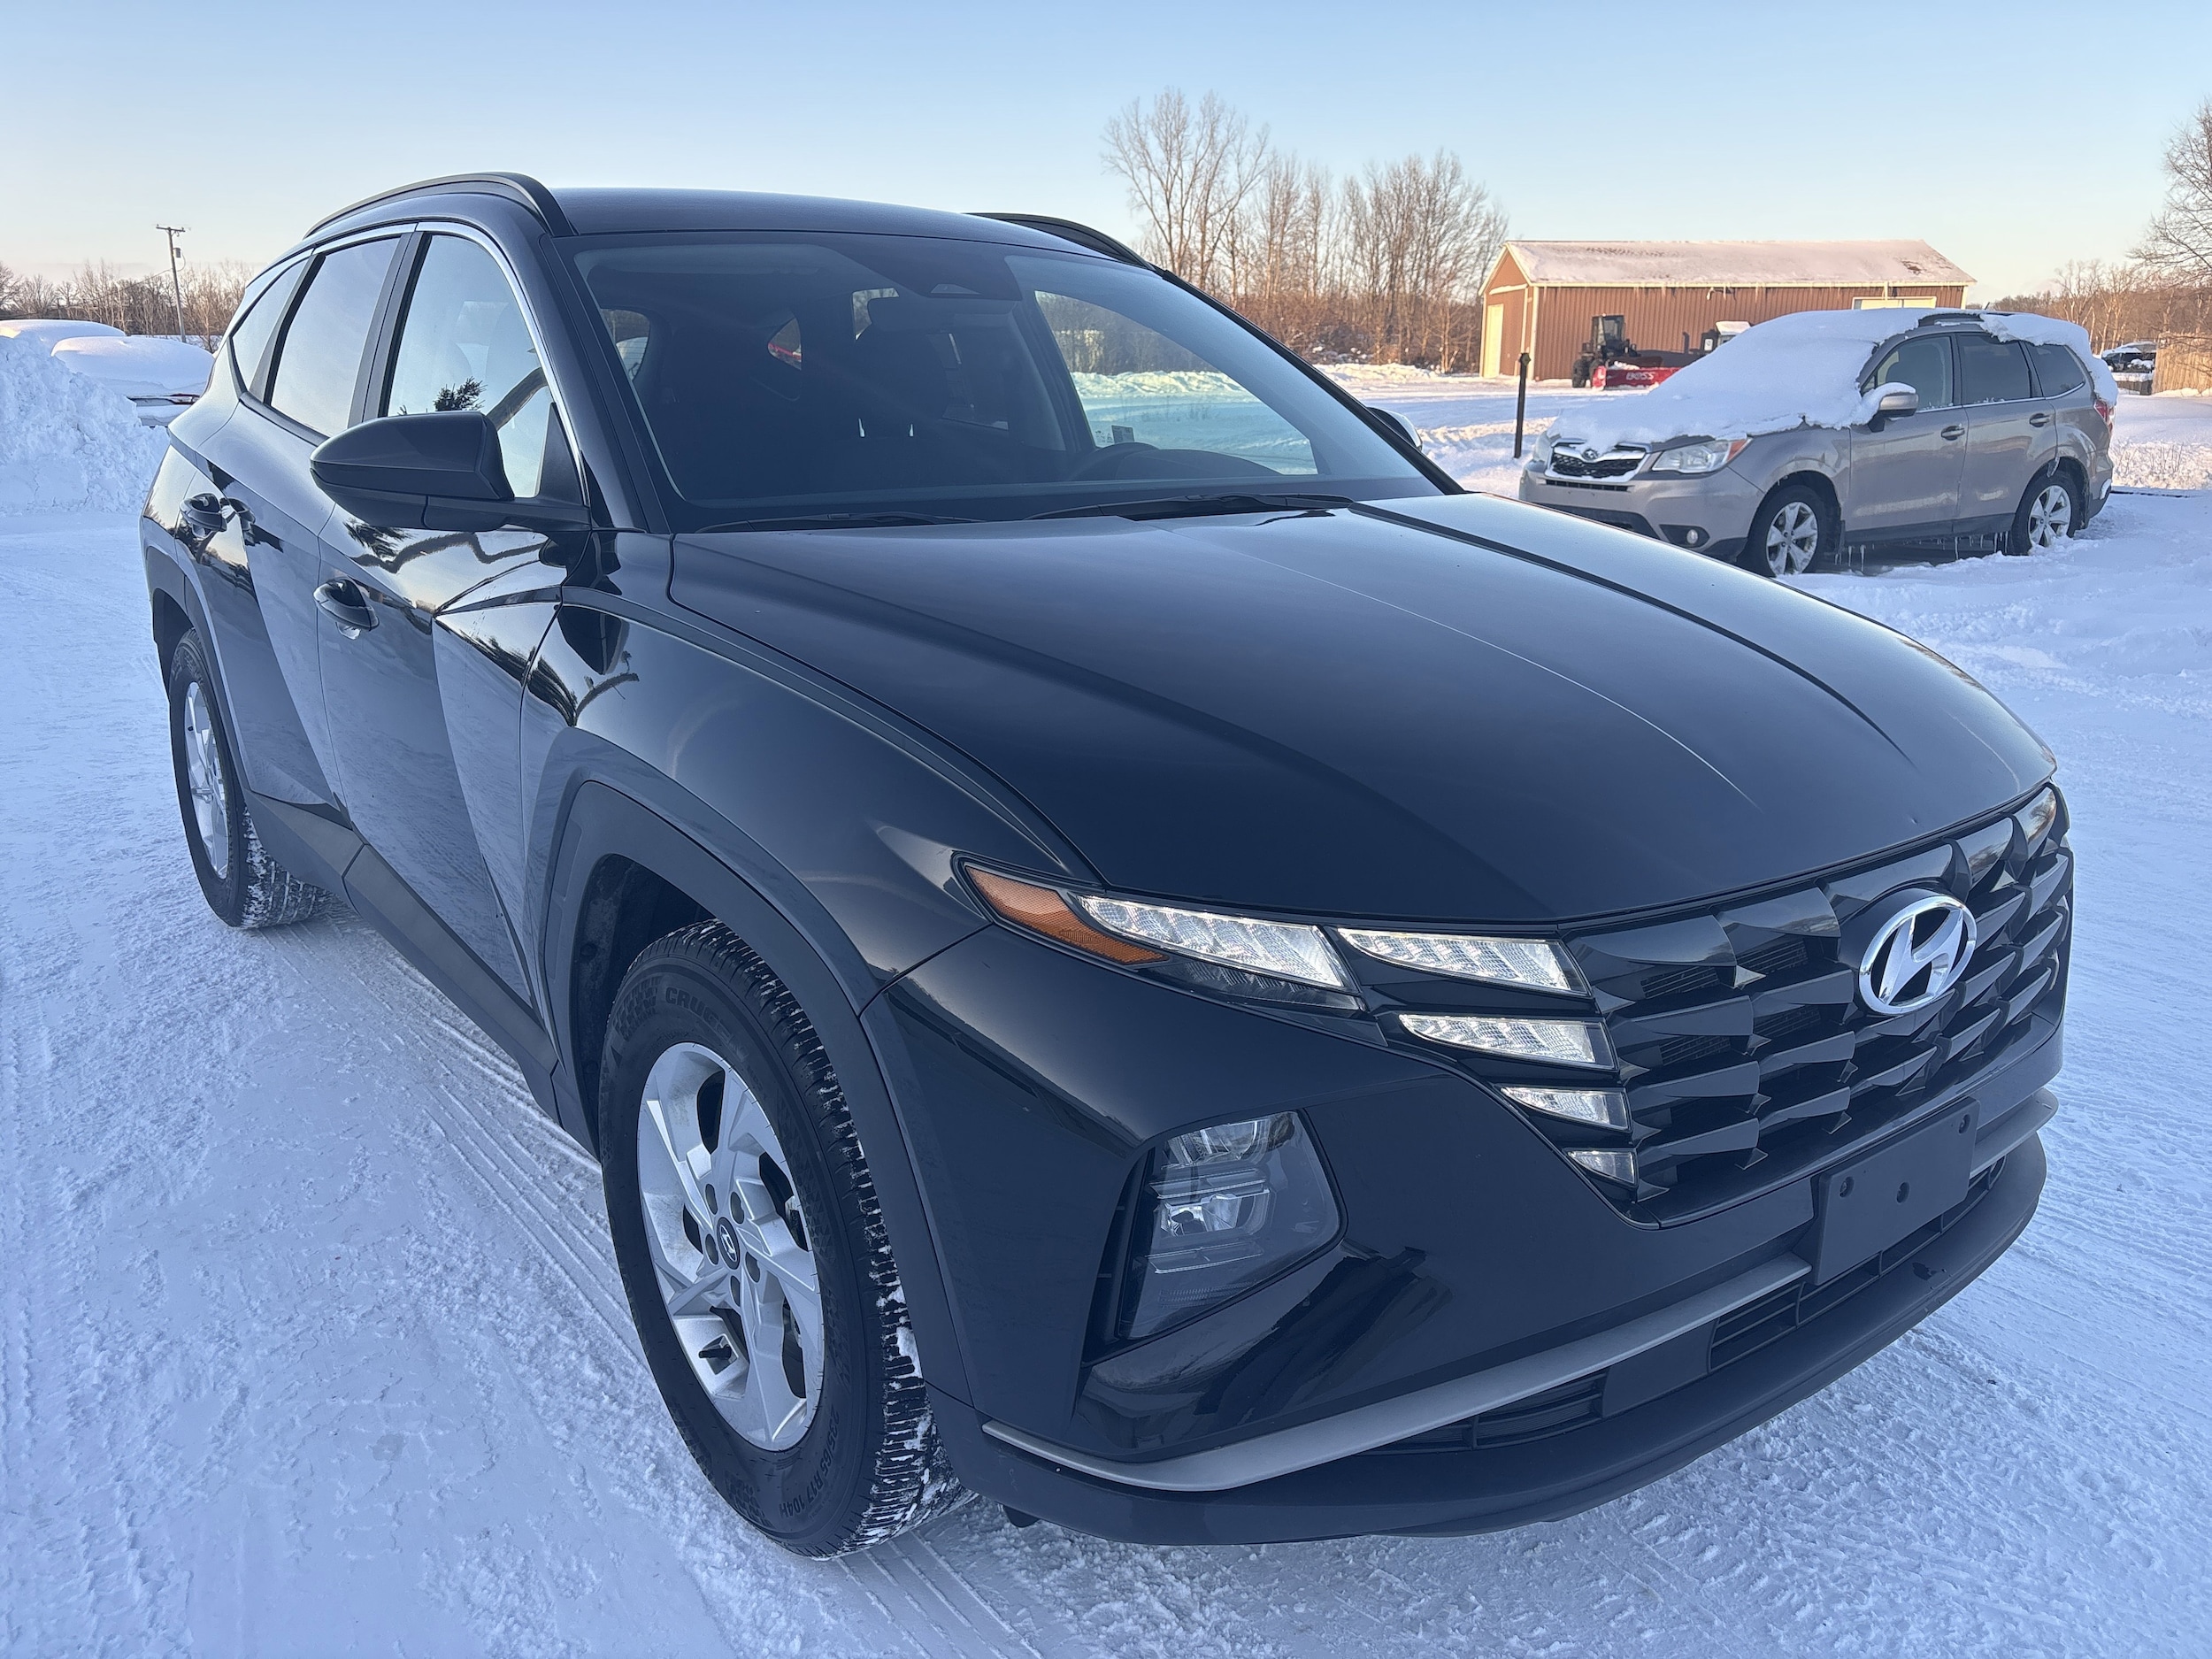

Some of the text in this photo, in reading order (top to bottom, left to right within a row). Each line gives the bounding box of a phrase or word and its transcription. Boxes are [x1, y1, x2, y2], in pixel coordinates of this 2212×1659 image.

[1626, 372, 1655, 380] BOSS
[819, 1405, 840, 1479] 235/65
[806, 1471, 824, 1503] R17
[779, 1494, 805, 1518] 104H
